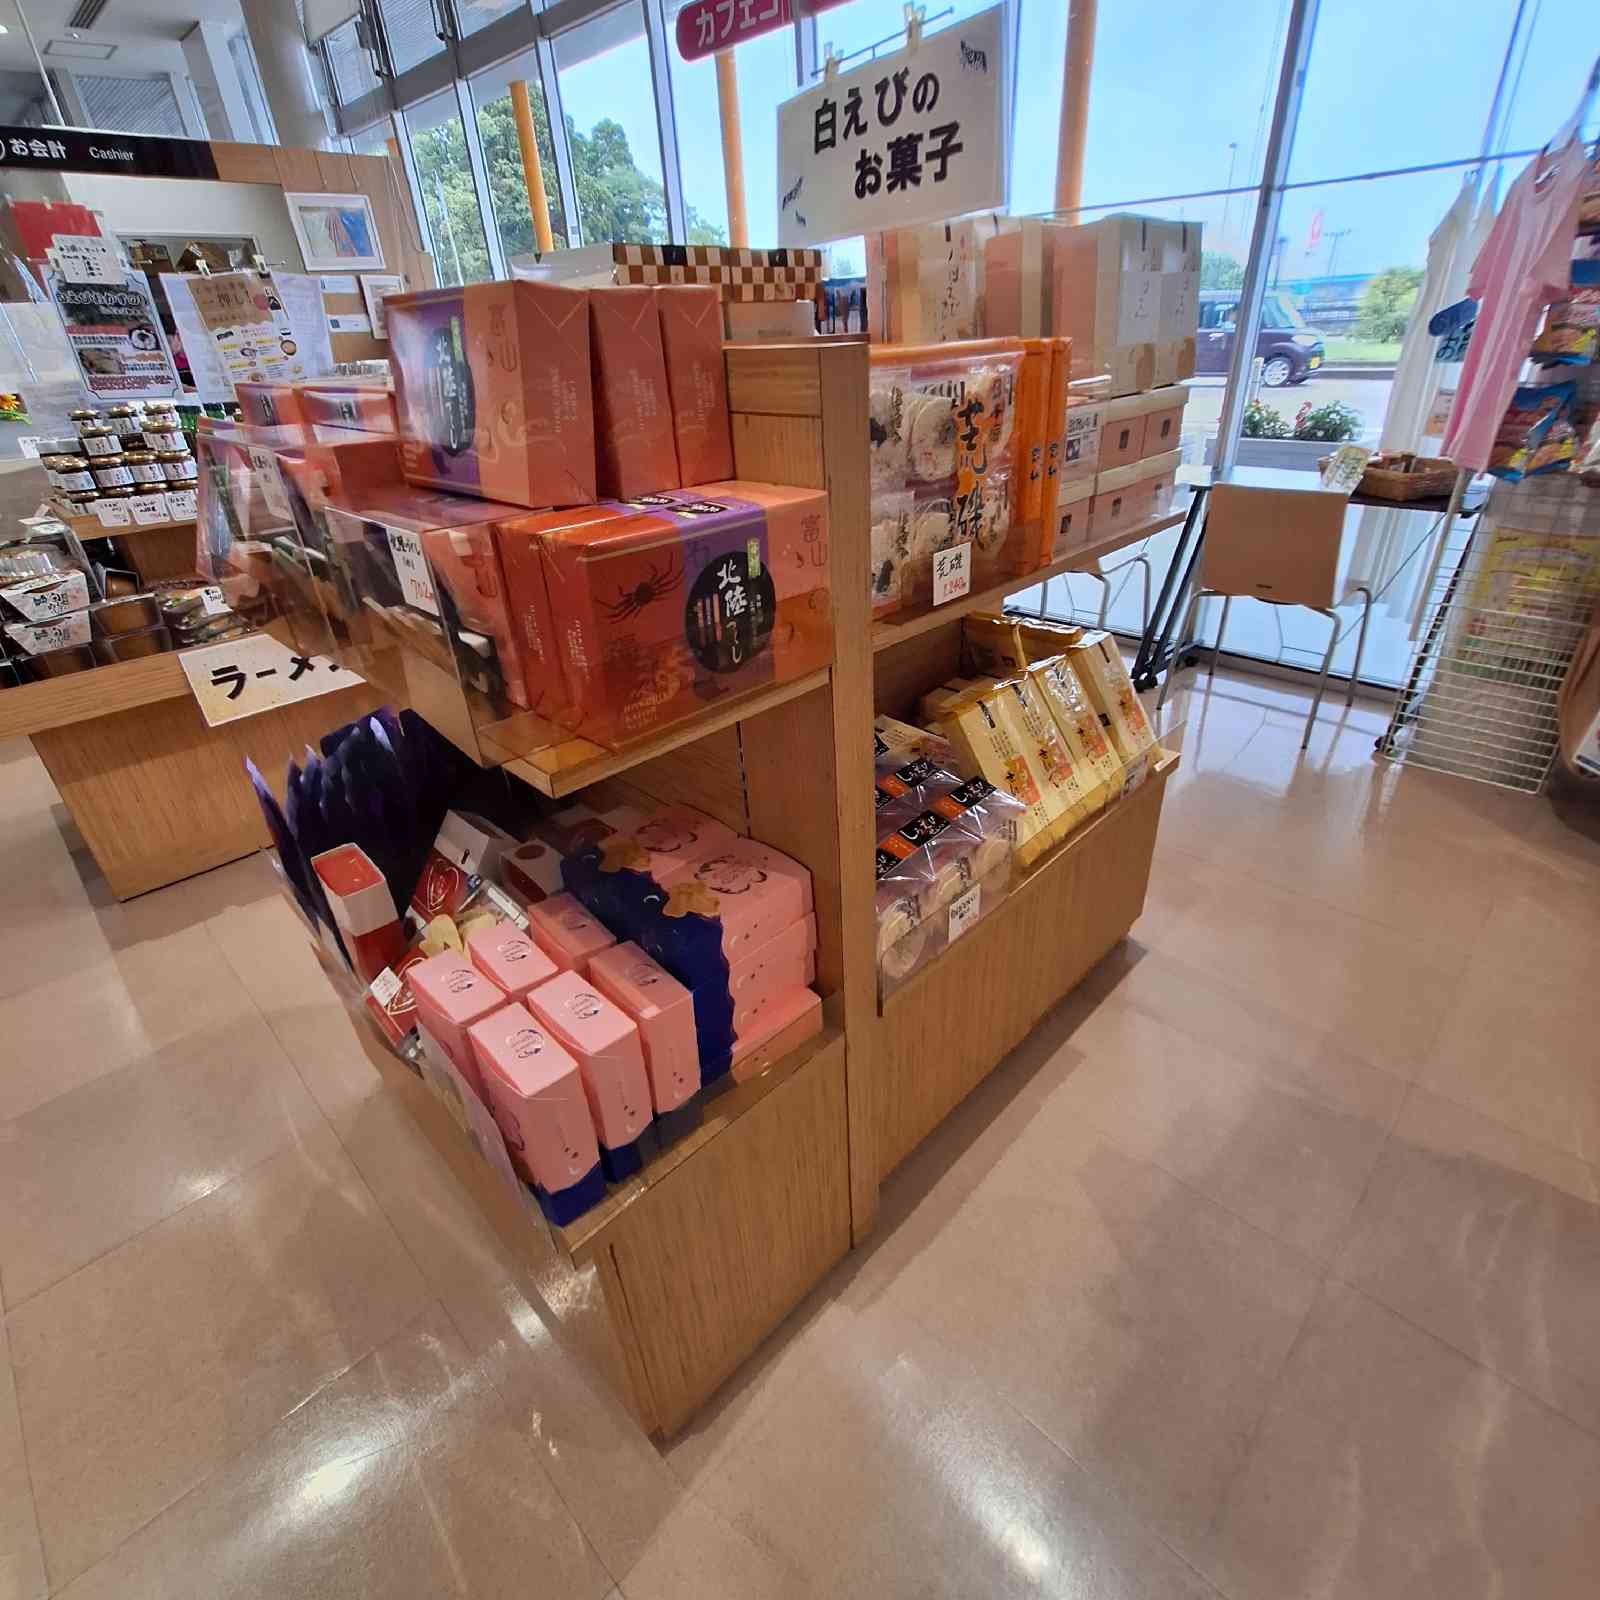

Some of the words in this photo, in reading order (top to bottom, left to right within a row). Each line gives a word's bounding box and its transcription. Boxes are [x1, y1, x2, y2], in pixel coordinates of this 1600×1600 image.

[814, 67, 940, 154] 白えびの
[9, 138, 66, 159] お会計
[89, 146, 135, 161] Cashier
[855, 121, 963, 199] お菓子
[211, 656, 340, 700] ラーメ
